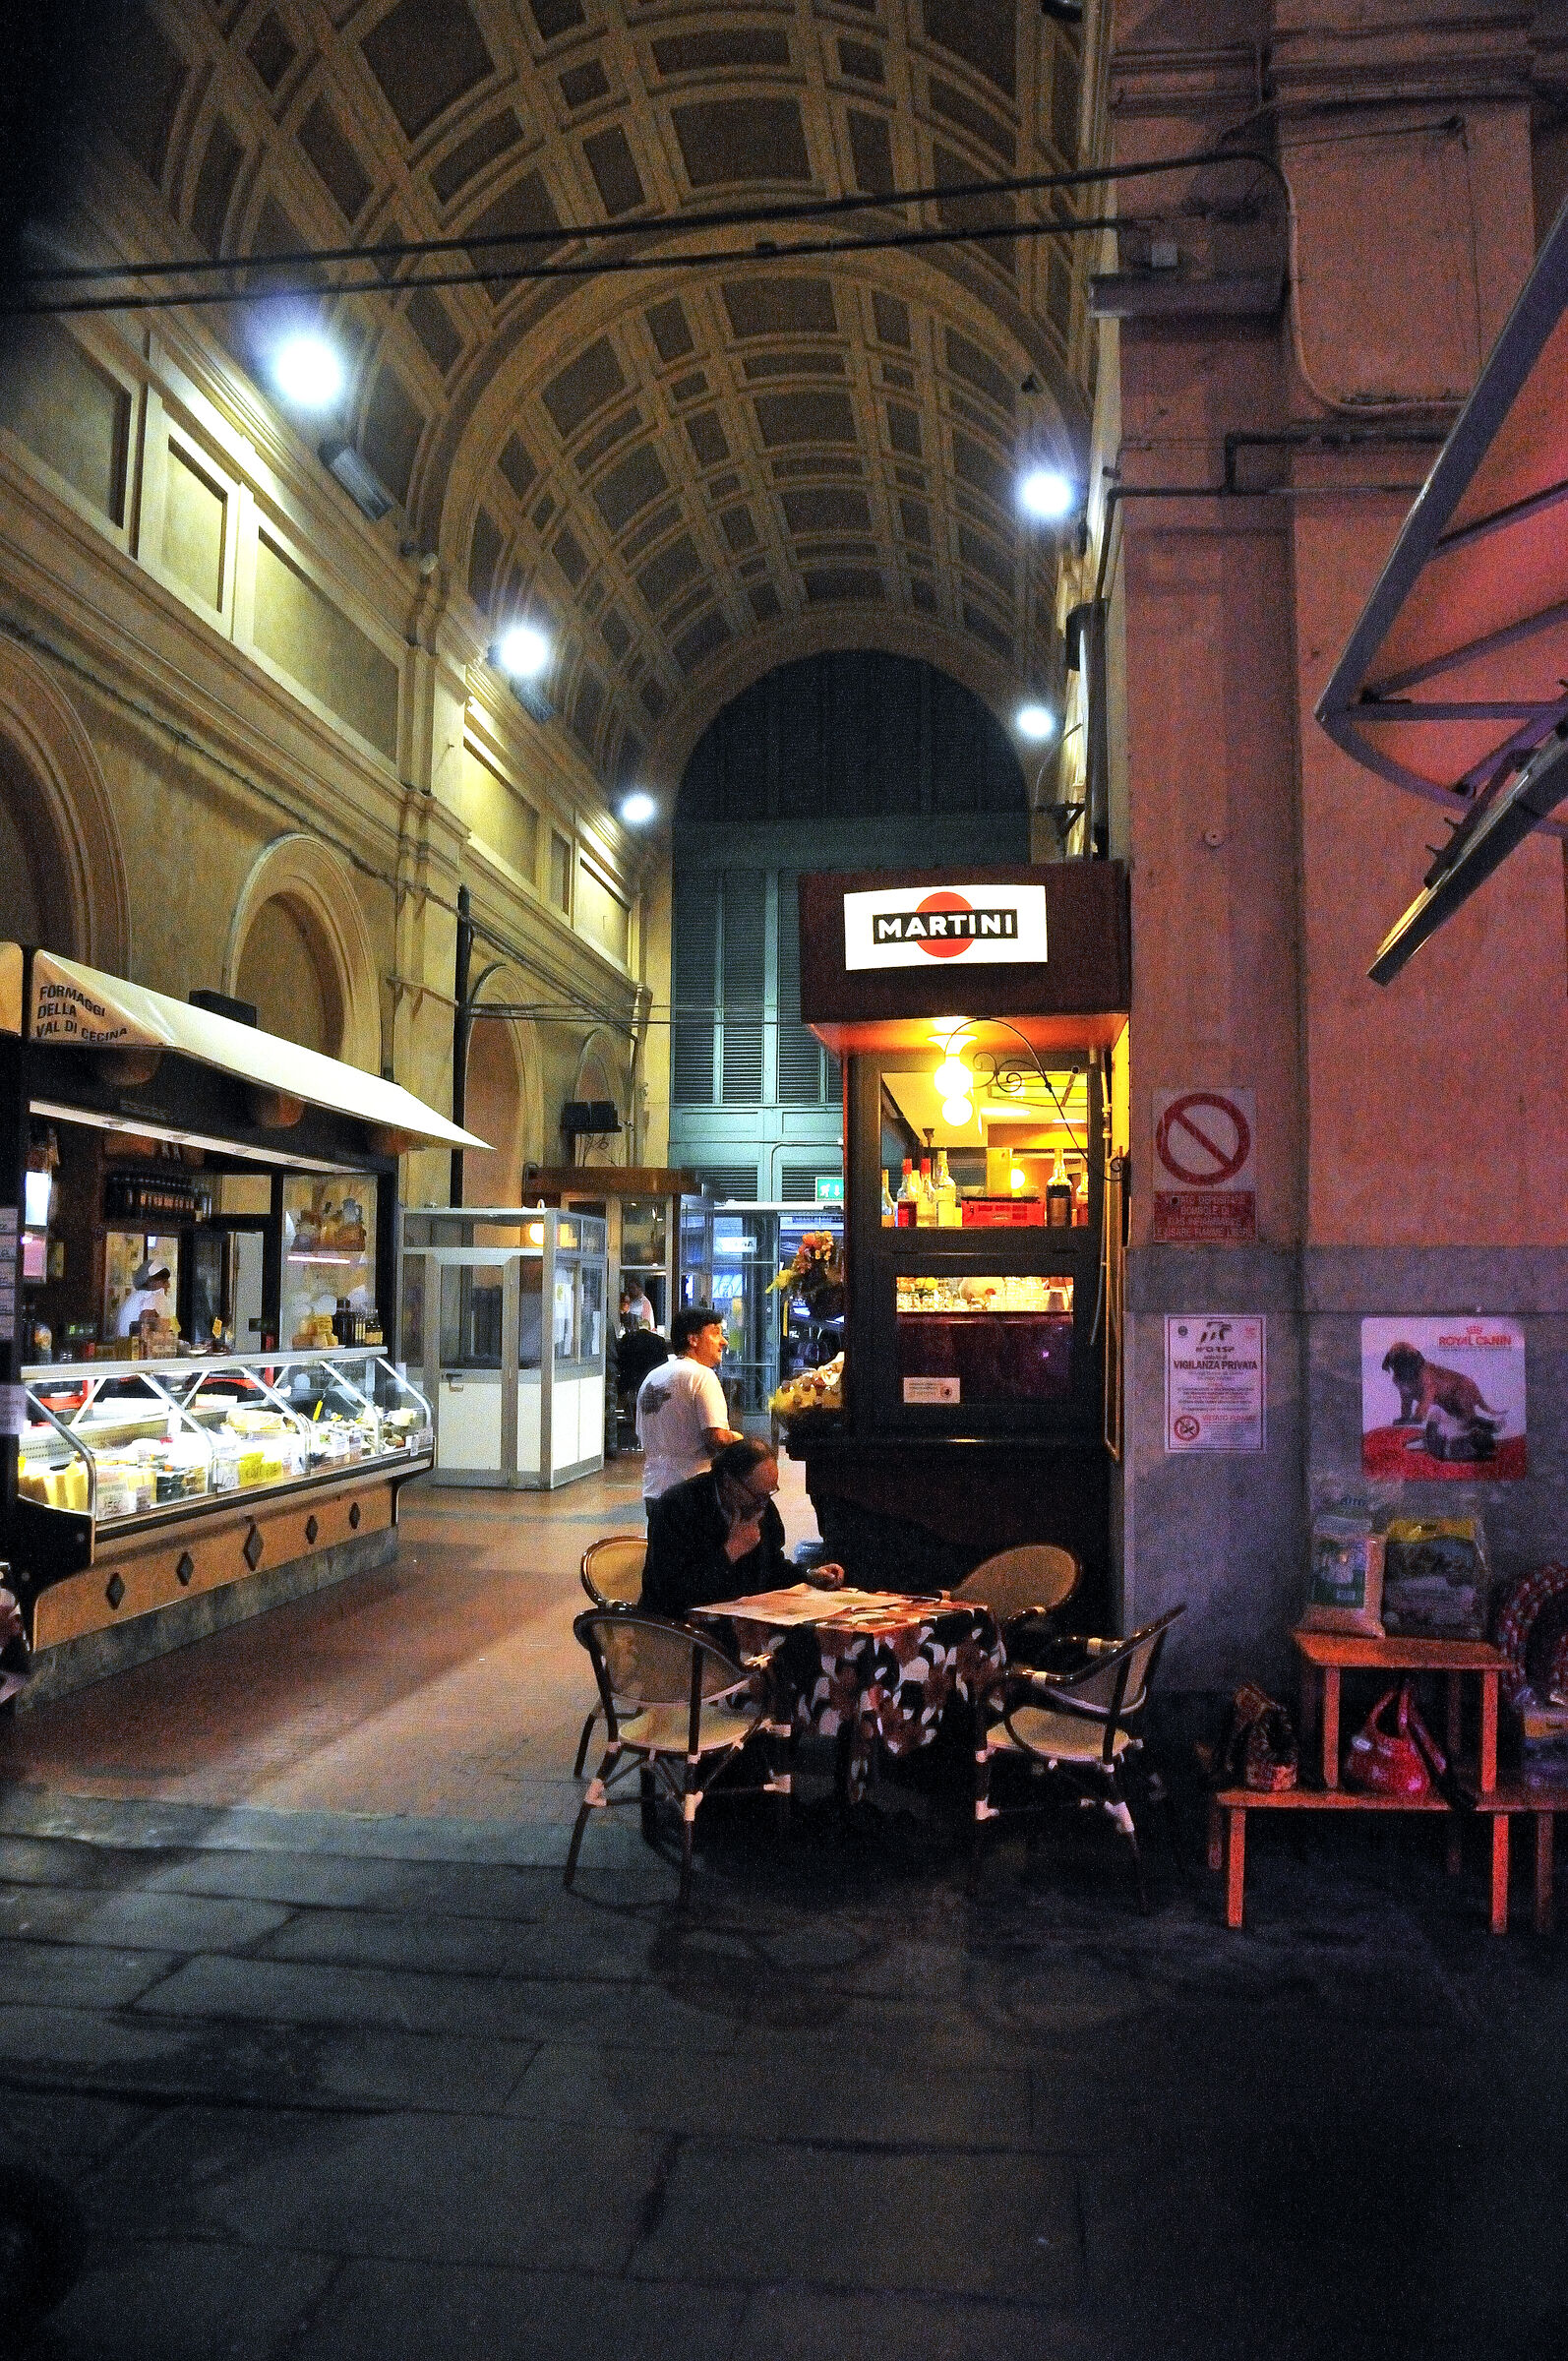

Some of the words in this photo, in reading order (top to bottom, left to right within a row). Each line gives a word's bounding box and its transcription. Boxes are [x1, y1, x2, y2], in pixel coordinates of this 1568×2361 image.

[878, 914, 1013, 939] MARTINI
[37, 1002, 78, 1019] DELLA
[39, 985, 105, 1017] FORMAGGI
[36, 1021, 60, 1038] VAL
[64, 1019, 78, 1034] DI
[81, 1027, 128, 1042] CECINA
[1438, 1336, 1474, 1346] ROYAL
[1476, 1335, 1512, 1346] CANIN
[1174, 1360, 1220, 1370] VIGILANZA
[1221, 1360, 1258, 1370] PRIVATA
